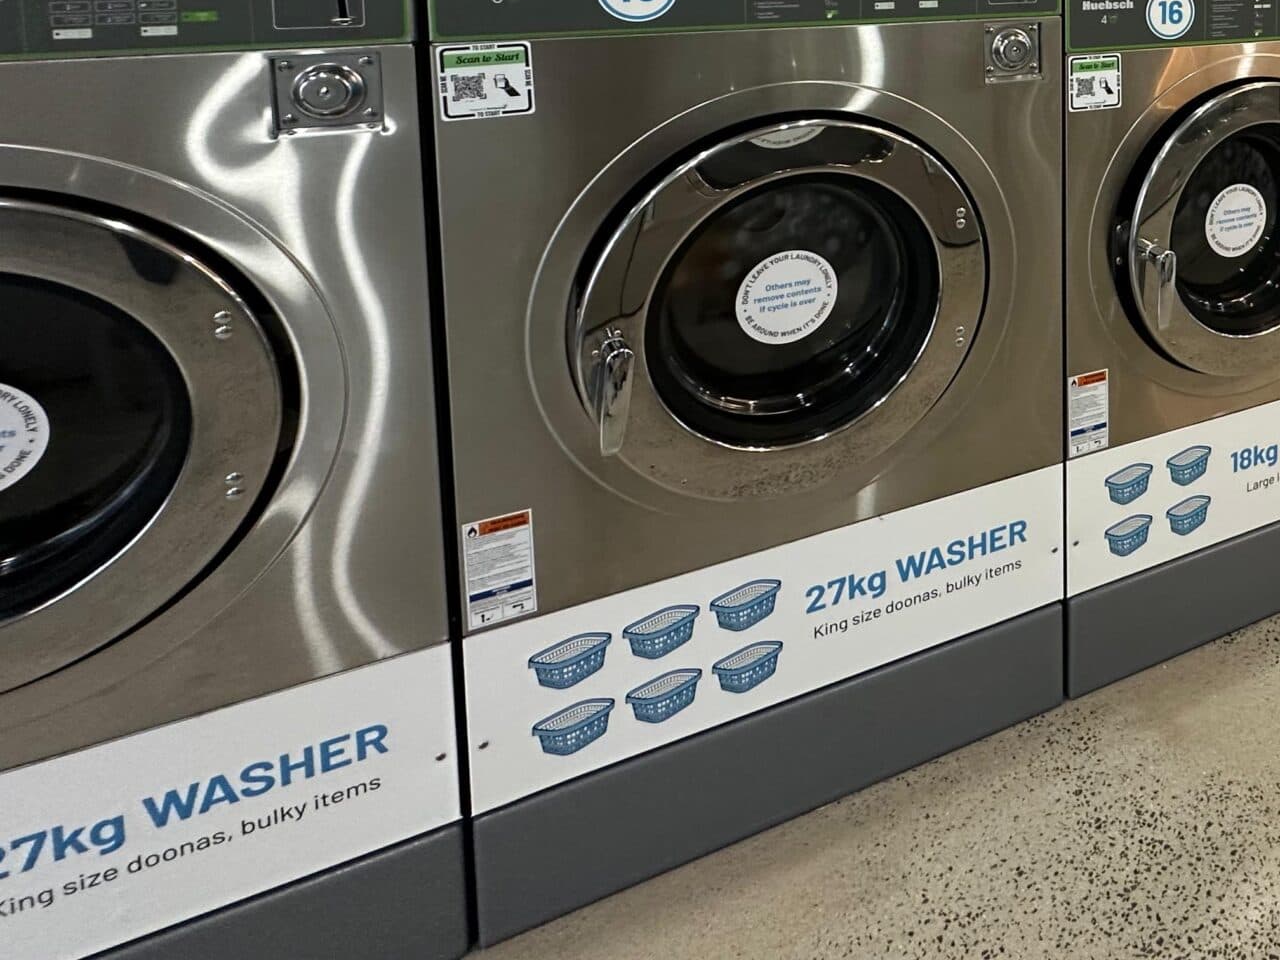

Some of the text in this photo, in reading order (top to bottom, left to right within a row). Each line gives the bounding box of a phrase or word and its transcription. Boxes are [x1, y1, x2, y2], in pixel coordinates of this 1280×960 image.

[1082, 0, 1134, 11] Huebsch
[1158, 0, 1183, 25] 16
[455, 55, 480, 65] Scan
[494, 52, 520, 62] Start
[742, 253, 832, 306] DON'T LEAVE YOUR LAUNDRY LONELY
[765, 278, 811, 292] Others may
[753, 286, 822, 304] remove contents
[759, 305, 765, 313] if
[767, 303, 788, 312] cycle
[798, 297, 816, 306] over
[752, 322, 779, 338] AROUND
[781, 326, 802, 337] WHEN
[814, 301, 829, 319] DONE
[13, 400, 38, 433] LONELY
[3, 449, 32, 474] DONE
[1230, 443, 1279, 473] 18kg
[1246, 477, 1275, 493] Large
[805, 519, 1028, 615] 27kg WASHER
[813, 559, 1022, 640] King size doonas, bulky items
[0, 723, 390, 879] 7kg WASHER
[63, 866, 119, 897] size
[126, 829, 234, 874] doonas,
[241, 800, 308, 837] bulky
[312, 776, 383, 812] items
